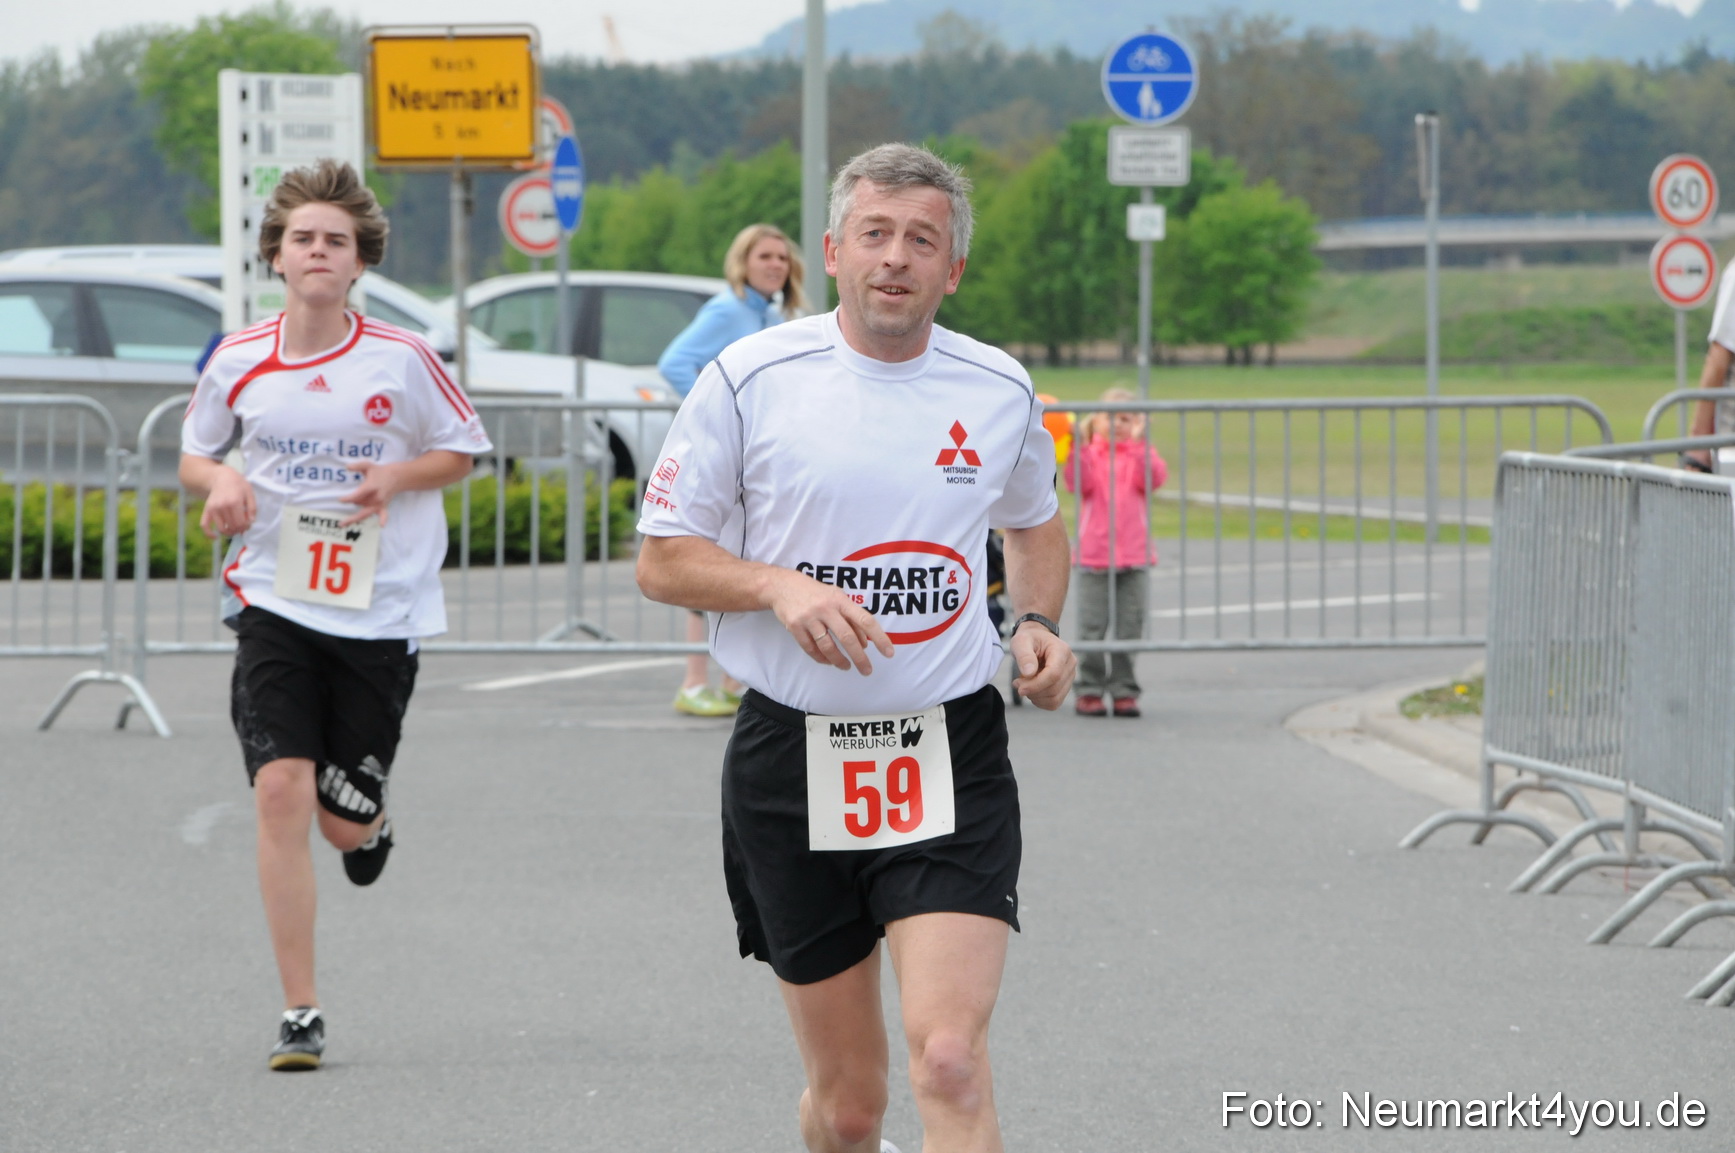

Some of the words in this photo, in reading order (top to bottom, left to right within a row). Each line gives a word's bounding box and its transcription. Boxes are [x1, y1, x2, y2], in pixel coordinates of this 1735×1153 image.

[387, 80, 520, 111] Neumarkt
[1667, 176, 1703, 210] 60
[286, 461, 348, 483] jeans
[943, 466, 978, 475] MITSUBISHI
[946, 476, 976, 485] MOTORS
[307, 540, 353, 595] 15
[795, 562, 945, 590] GERHART
[947, 570, 958, 585] &
[829, 720, 896, 738] MEYER
[829, 736, 897, 750] WERBUNG
[842, 755, 924, 838] 59
